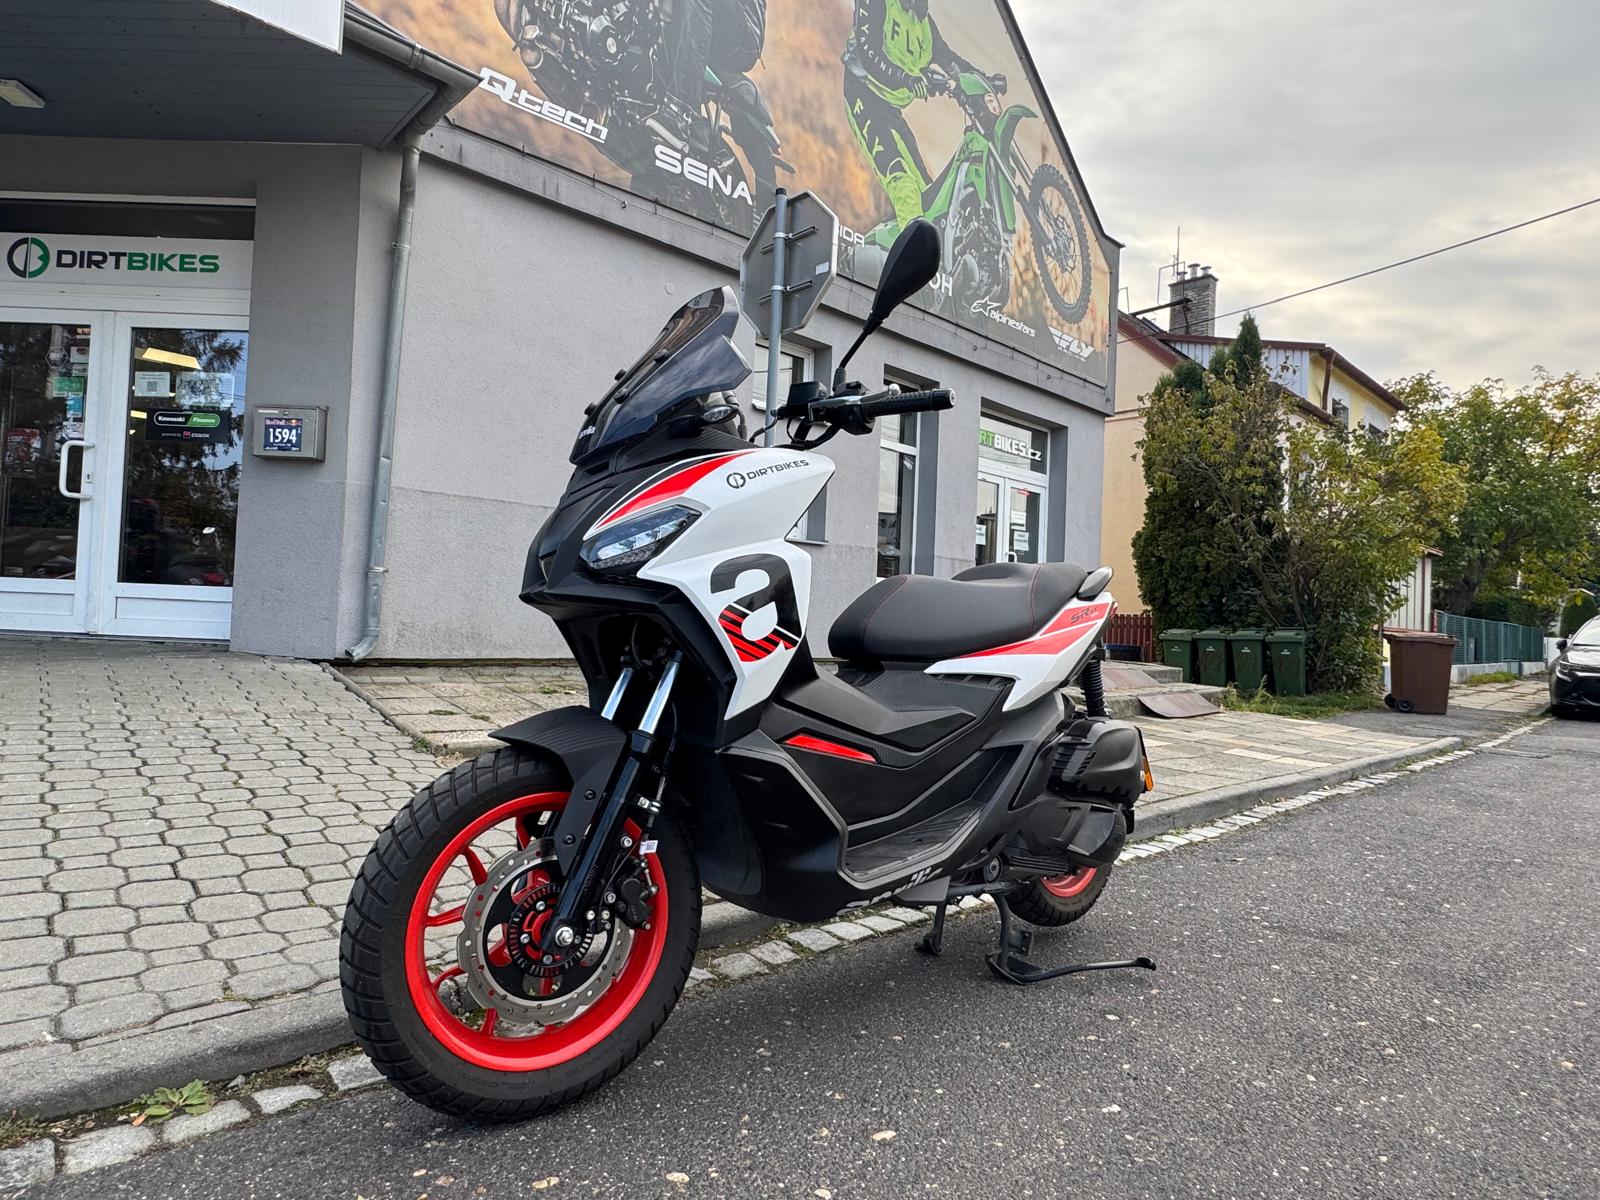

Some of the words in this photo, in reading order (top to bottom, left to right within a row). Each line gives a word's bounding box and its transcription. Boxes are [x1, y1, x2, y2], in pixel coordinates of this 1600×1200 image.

[654, 144, 753, 206] SENA
[56, 249, 220, 273] DIRTBIKES
[989, 309, 1036, 337] alpinestars
[1048, 325, 1095, 358] FLY
[269, 428, 297, 443] 1594
[746, 459, 810, 480] DIRTBIKES
